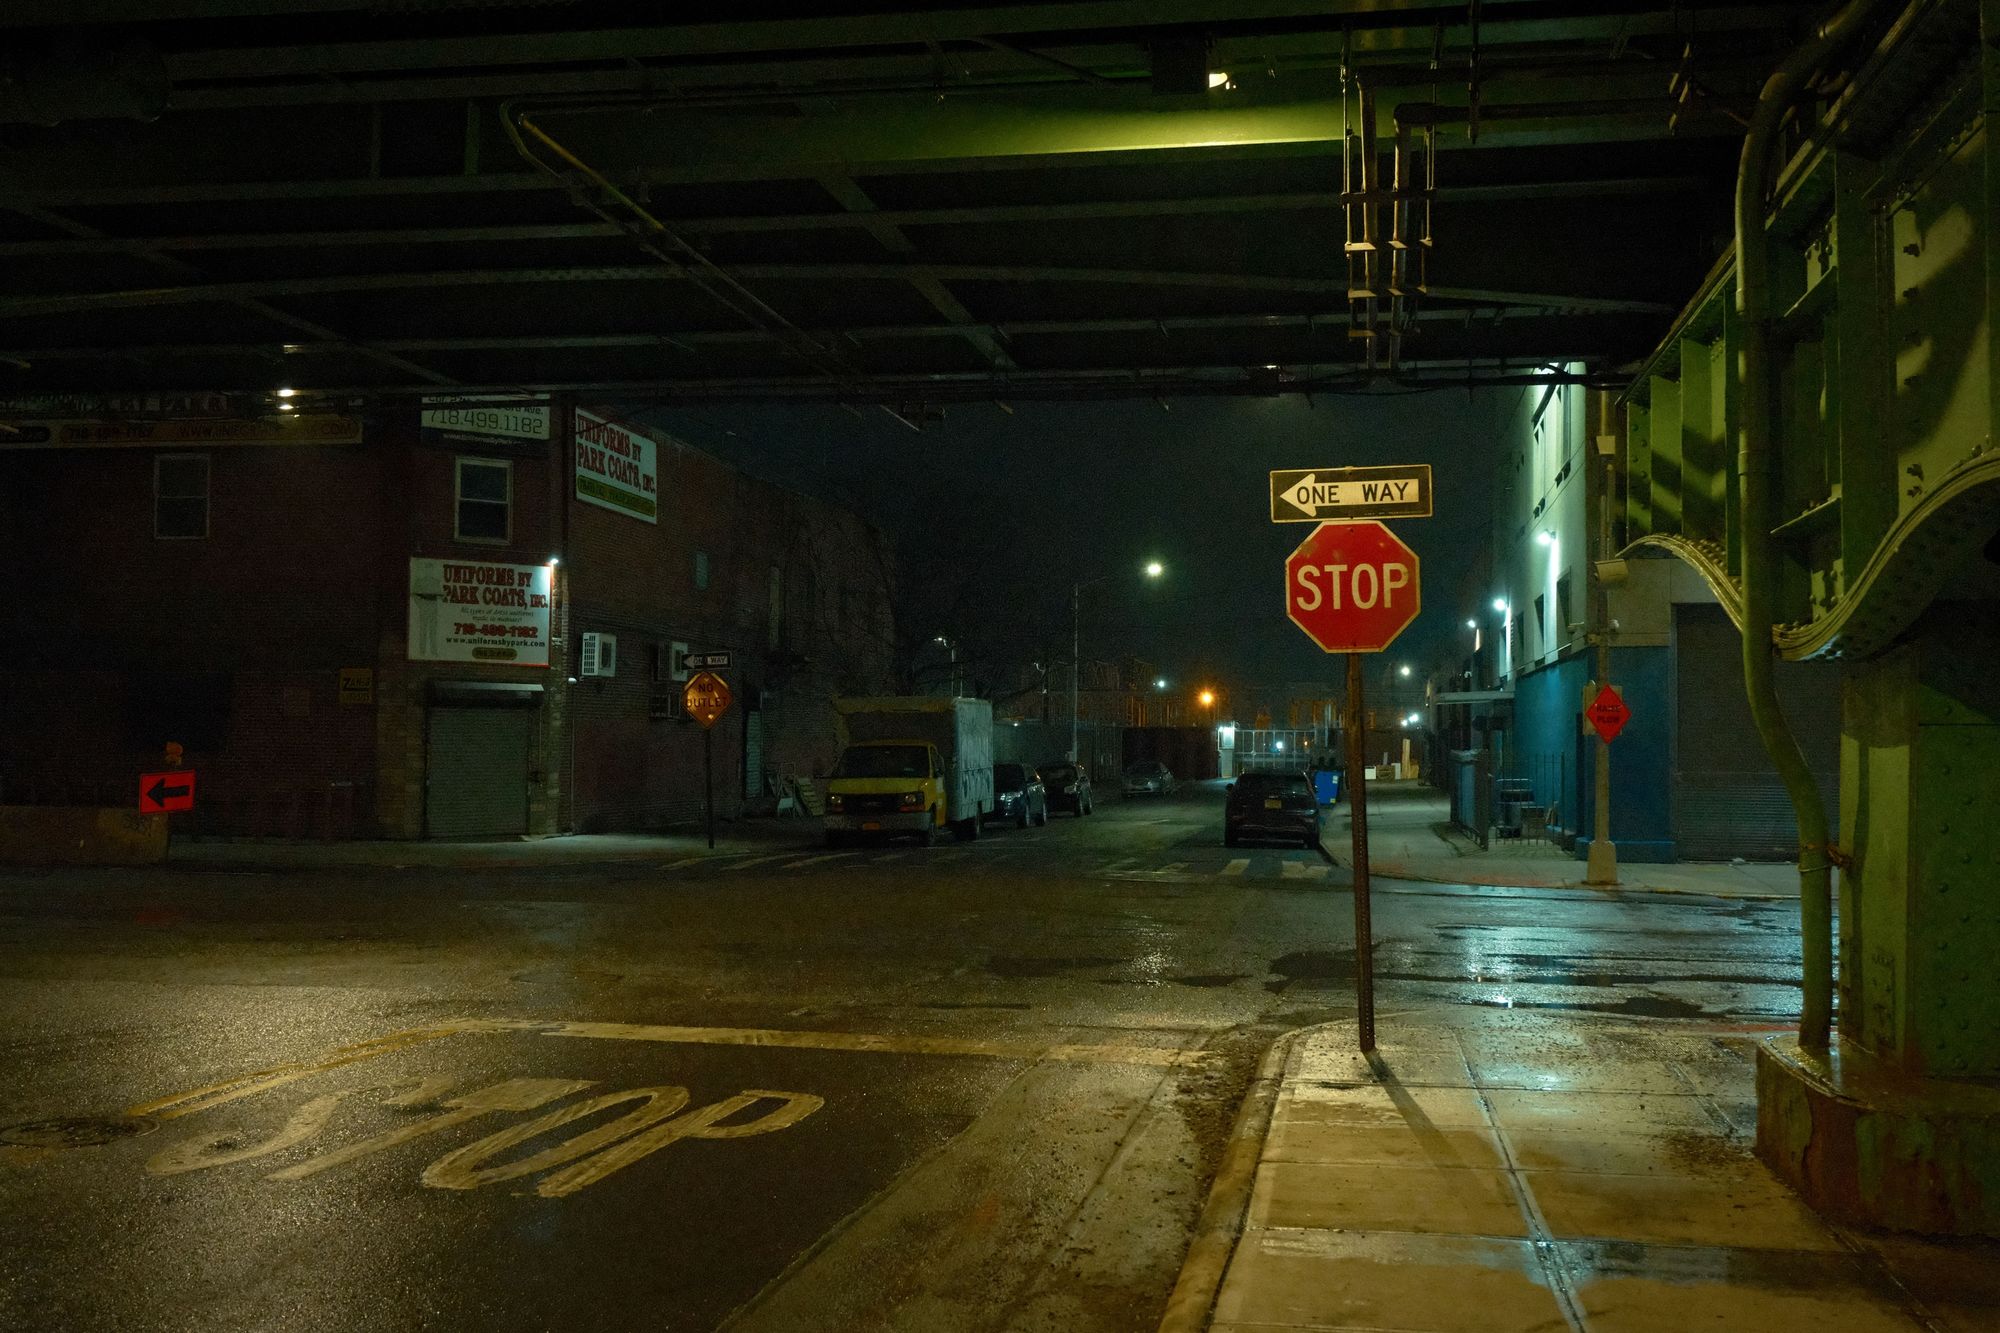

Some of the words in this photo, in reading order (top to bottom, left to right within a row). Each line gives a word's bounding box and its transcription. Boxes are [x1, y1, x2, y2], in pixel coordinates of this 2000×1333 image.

[577, 413, 631, 457] UNIFORMS
[632, 443, 642, 462] BY
[577, 442, 606, 475] PARK
[1296, 485, 1340, 505] ONE
[1362, 482, 1409, 502] WAY
[443, 564, 514, 586] UNIFORMS
[518, 572, 532, 587] BY
[1295, 562, 1410, 612] STOP
[442, 585, 479, 605] PARK
[483, 587, 527, 609] COATS,
[698, 683, 714, 692] NO
[686, 697, 727, 707] OUTLET
[145, 1074, 826, 1199] STOP
